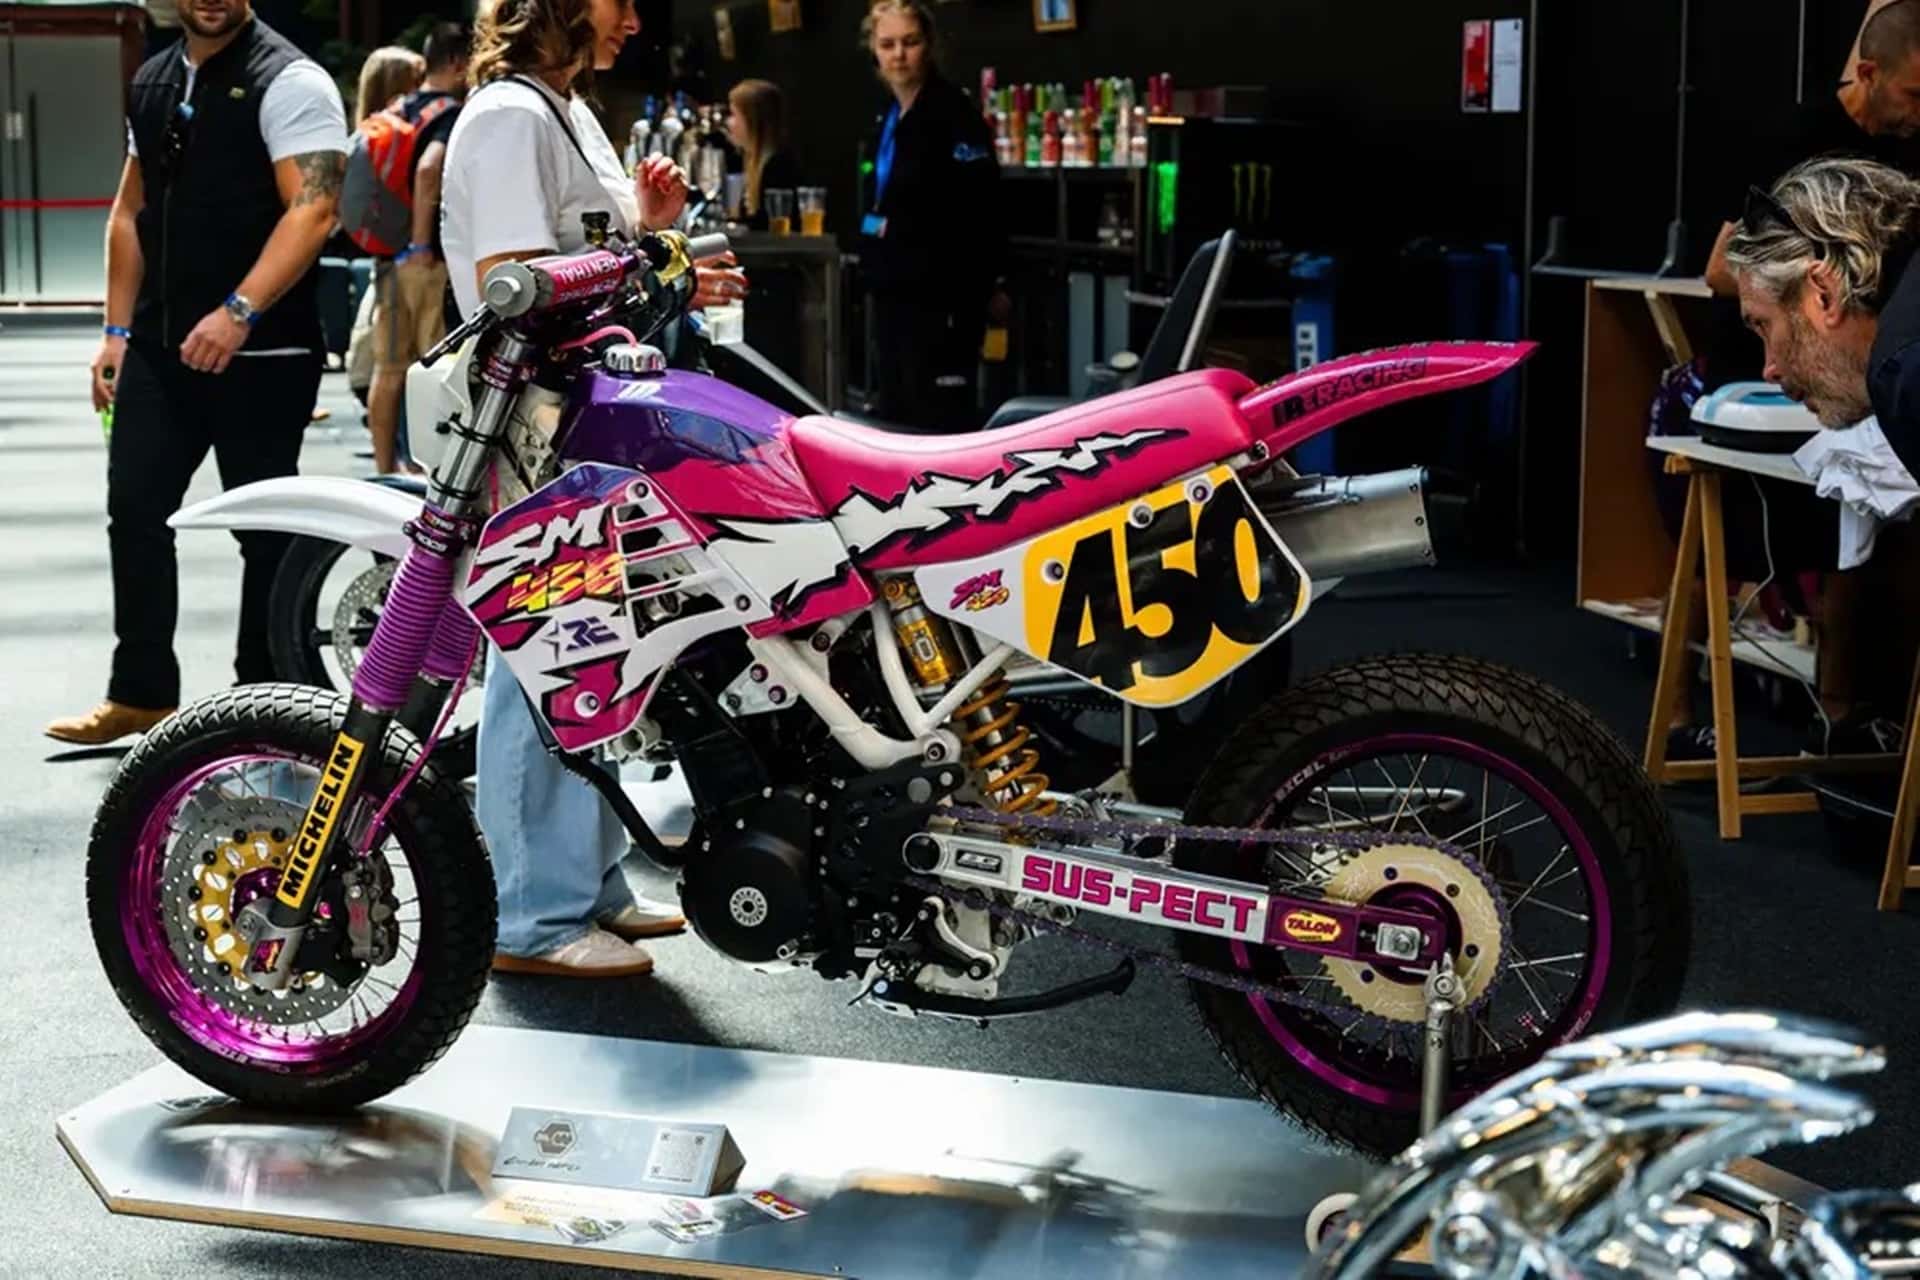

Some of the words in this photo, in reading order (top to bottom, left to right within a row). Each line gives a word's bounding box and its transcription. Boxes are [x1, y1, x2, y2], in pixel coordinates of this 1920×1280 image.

[556, 258, 618, 285] RENTHAL
[464, 503, 613, 606] SM
[950, 569, 1003, 610] SM
[1047, 478, 1302, 692] 450
[282, 743, 355, 899] MICHELIN
[1022, 855, 1257, 934] SUS-PECT
[1287, 918, 1337, 935] TALON
